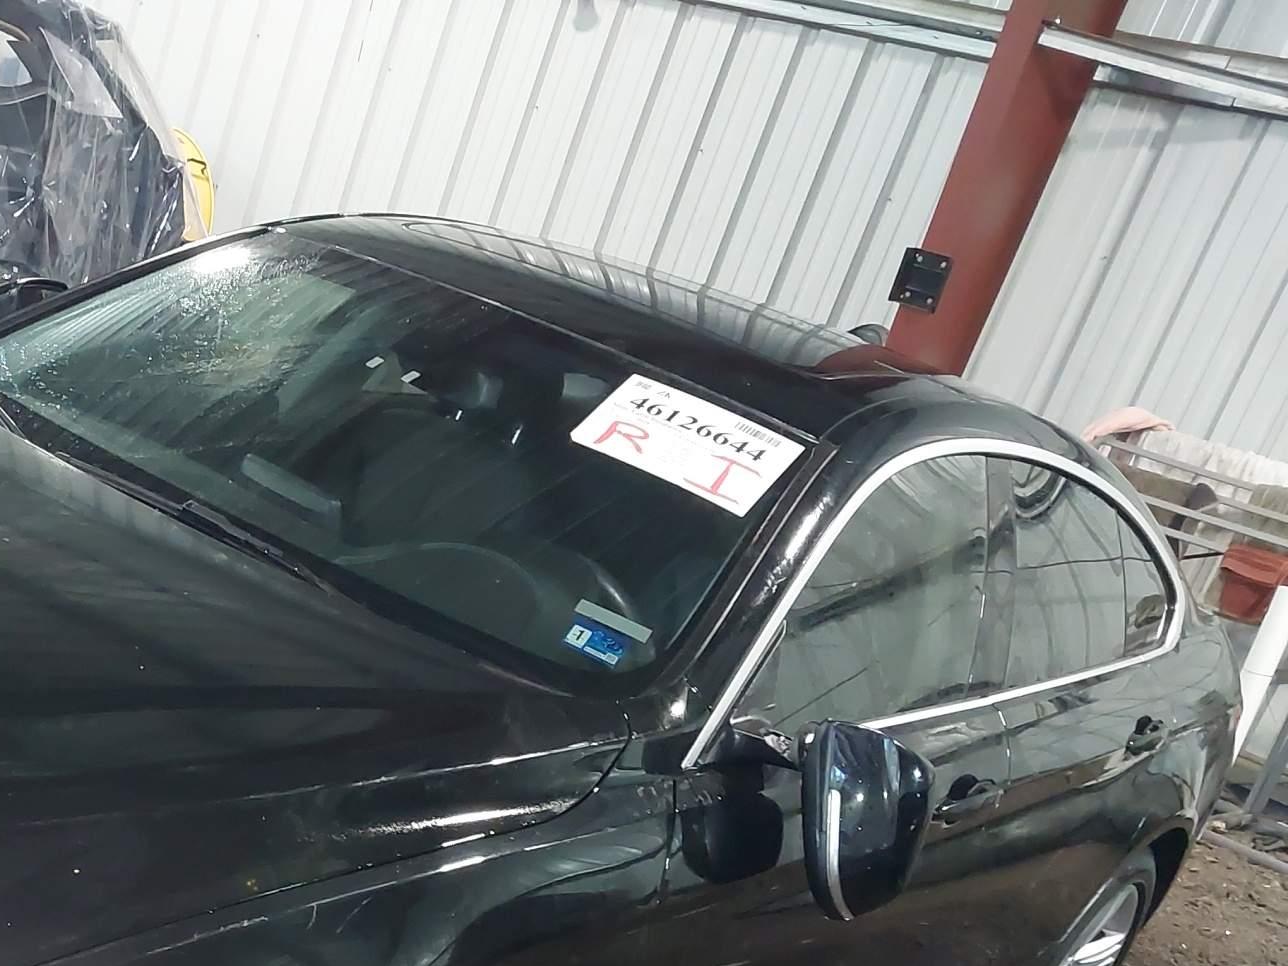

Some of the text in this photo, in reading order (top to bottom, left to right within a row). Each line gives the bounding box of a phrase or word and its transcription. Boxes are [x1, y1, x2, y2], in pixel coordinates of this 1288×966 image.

[593, 420, 650, 454] R
[629, 397, 768, 462] 46126644
[575, 629, 585, 641] 1
